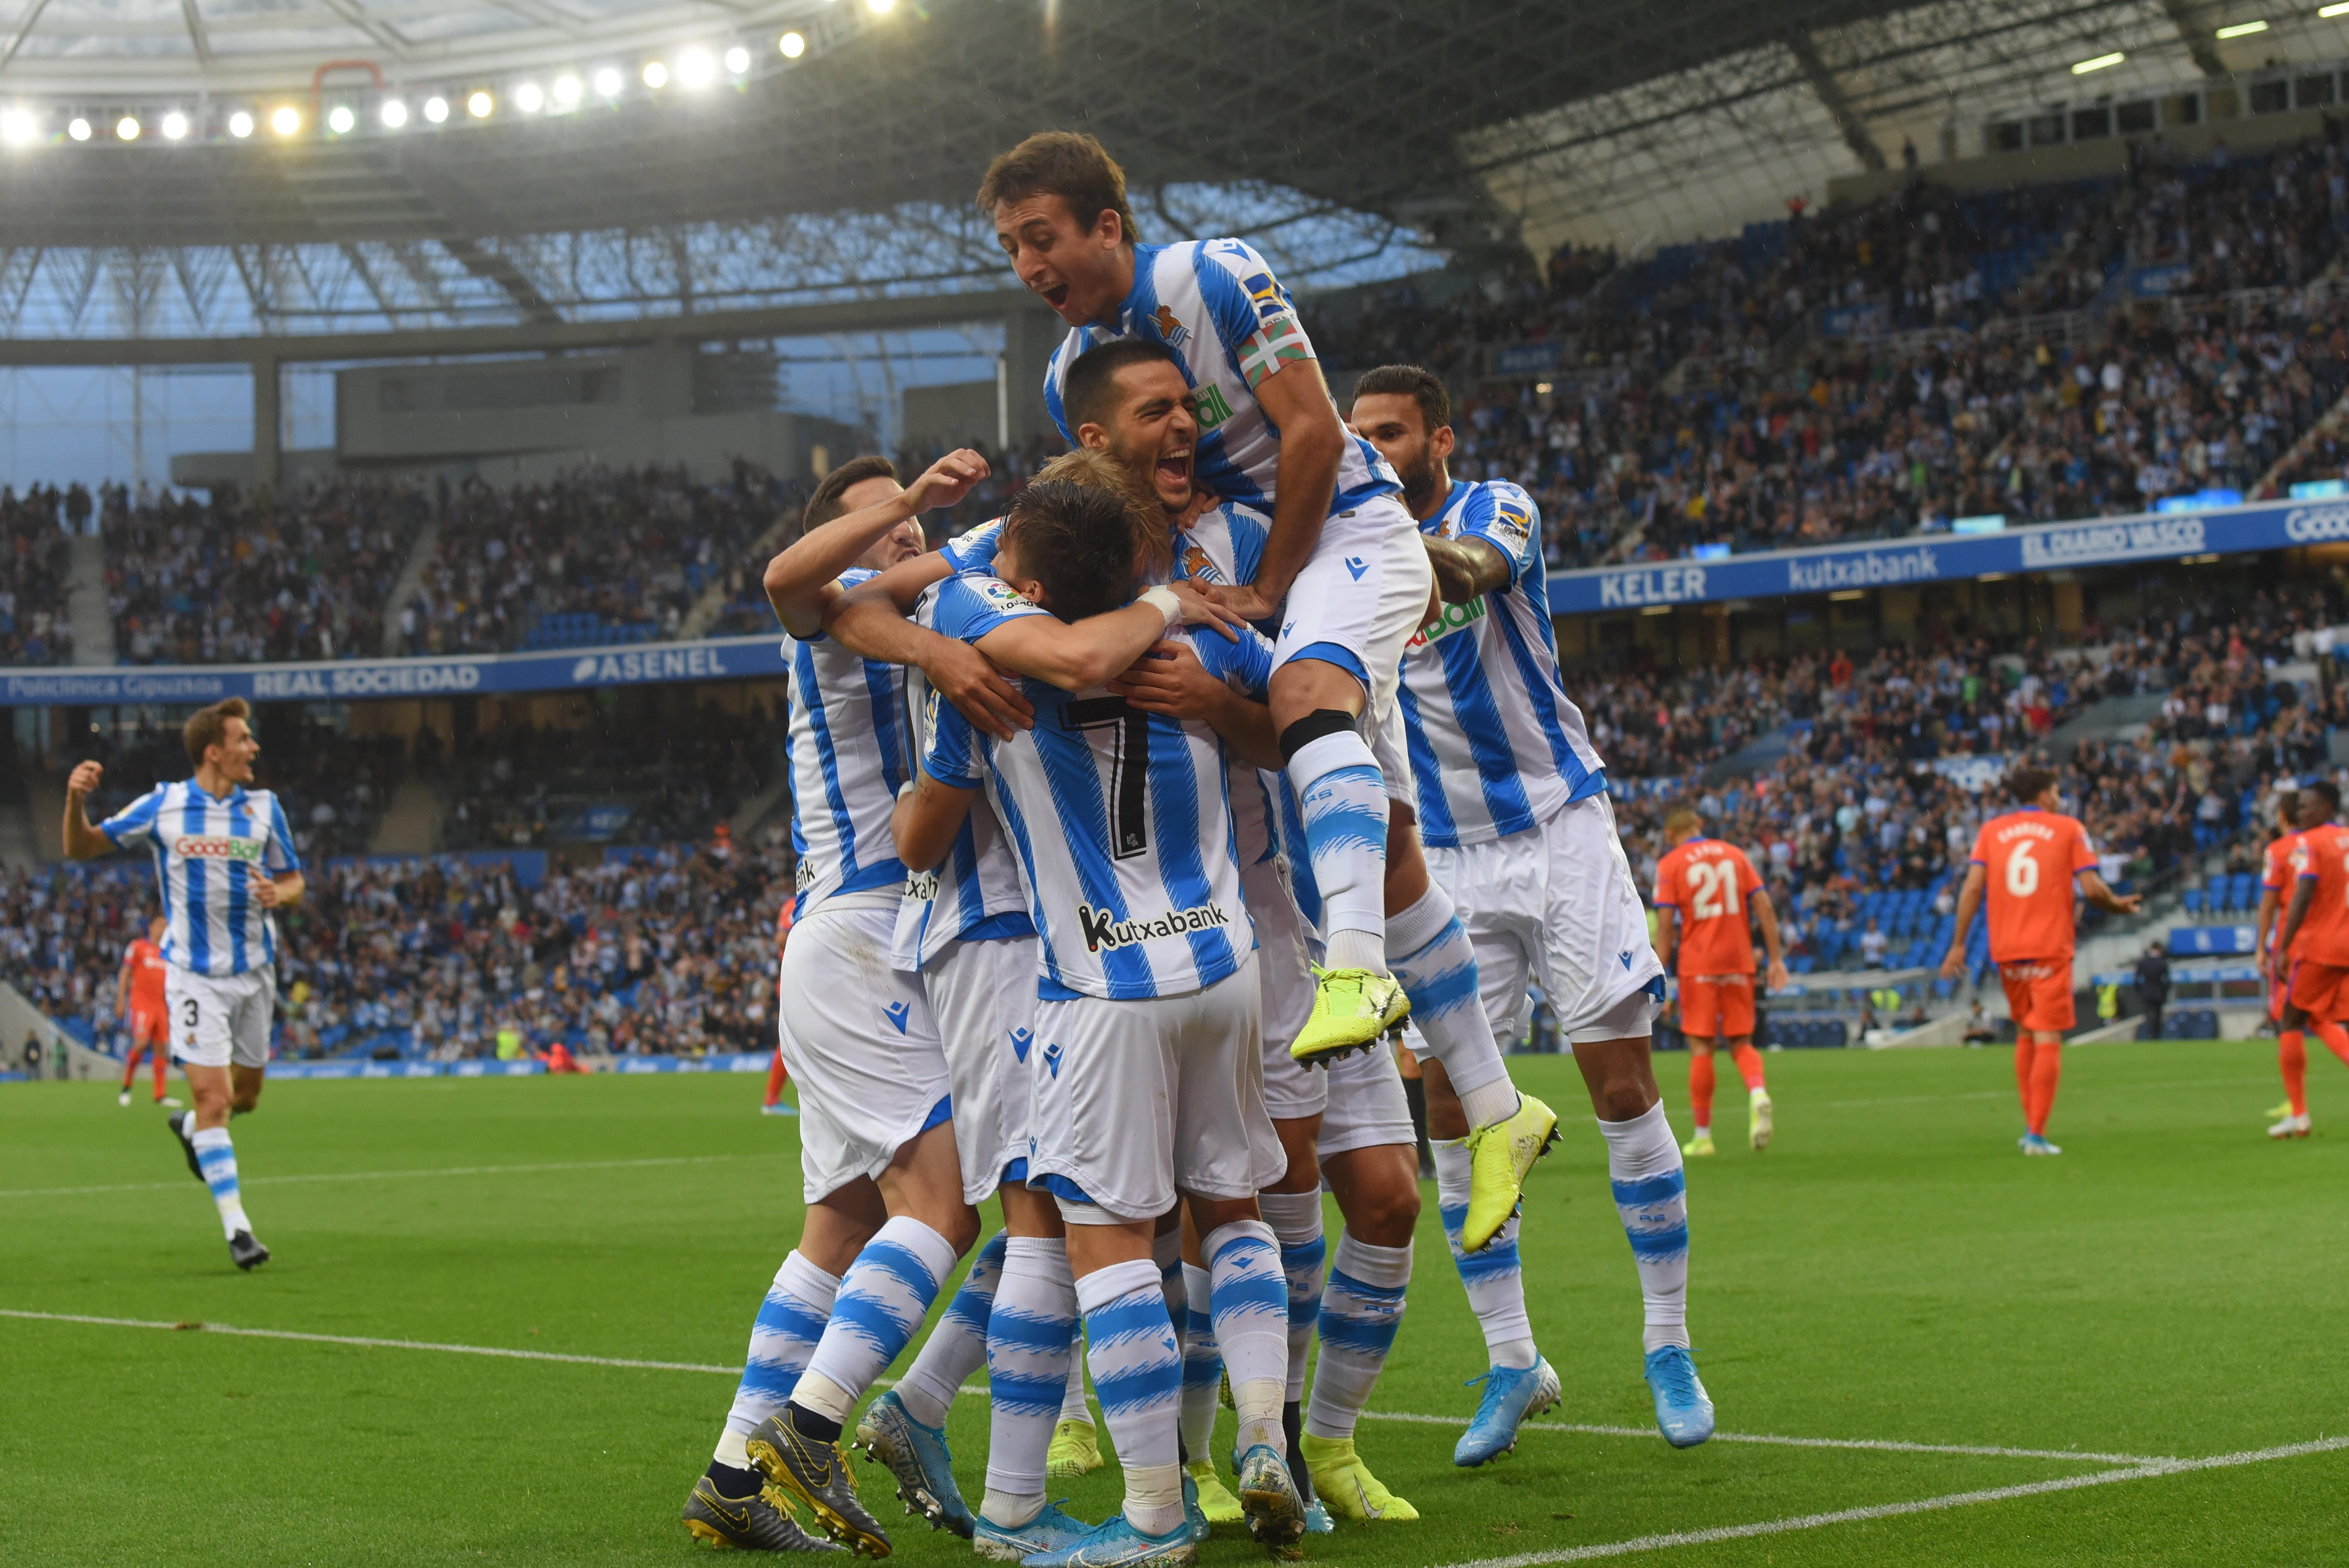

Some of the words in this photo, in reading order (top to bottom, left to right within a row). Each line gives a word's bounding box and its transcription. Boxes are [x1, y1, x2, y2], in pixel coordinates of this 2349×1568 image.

[2050, 527, 2127, 555] DIARIO
[2128, 519, 2205, 547] VASCO
[2285, 509, 2349, 542] Goo
[1600, 567, 1706, 607] KELER
[1788, 548, 1940, 590] kutxabank
[253, 672, 328, 697] REAL
[331, 665, 480, 695] SOCIEDAD
[599, 648, 727, 681] ASENEL
[1057, 696, 1149, 861] 7
[2006, 840, 2037, 897] 6
[1686, 859, 1739, 920] 21
[1079, 902, 1229, 952] Kutxabank
[184, 1000, 197, 1026] 3
